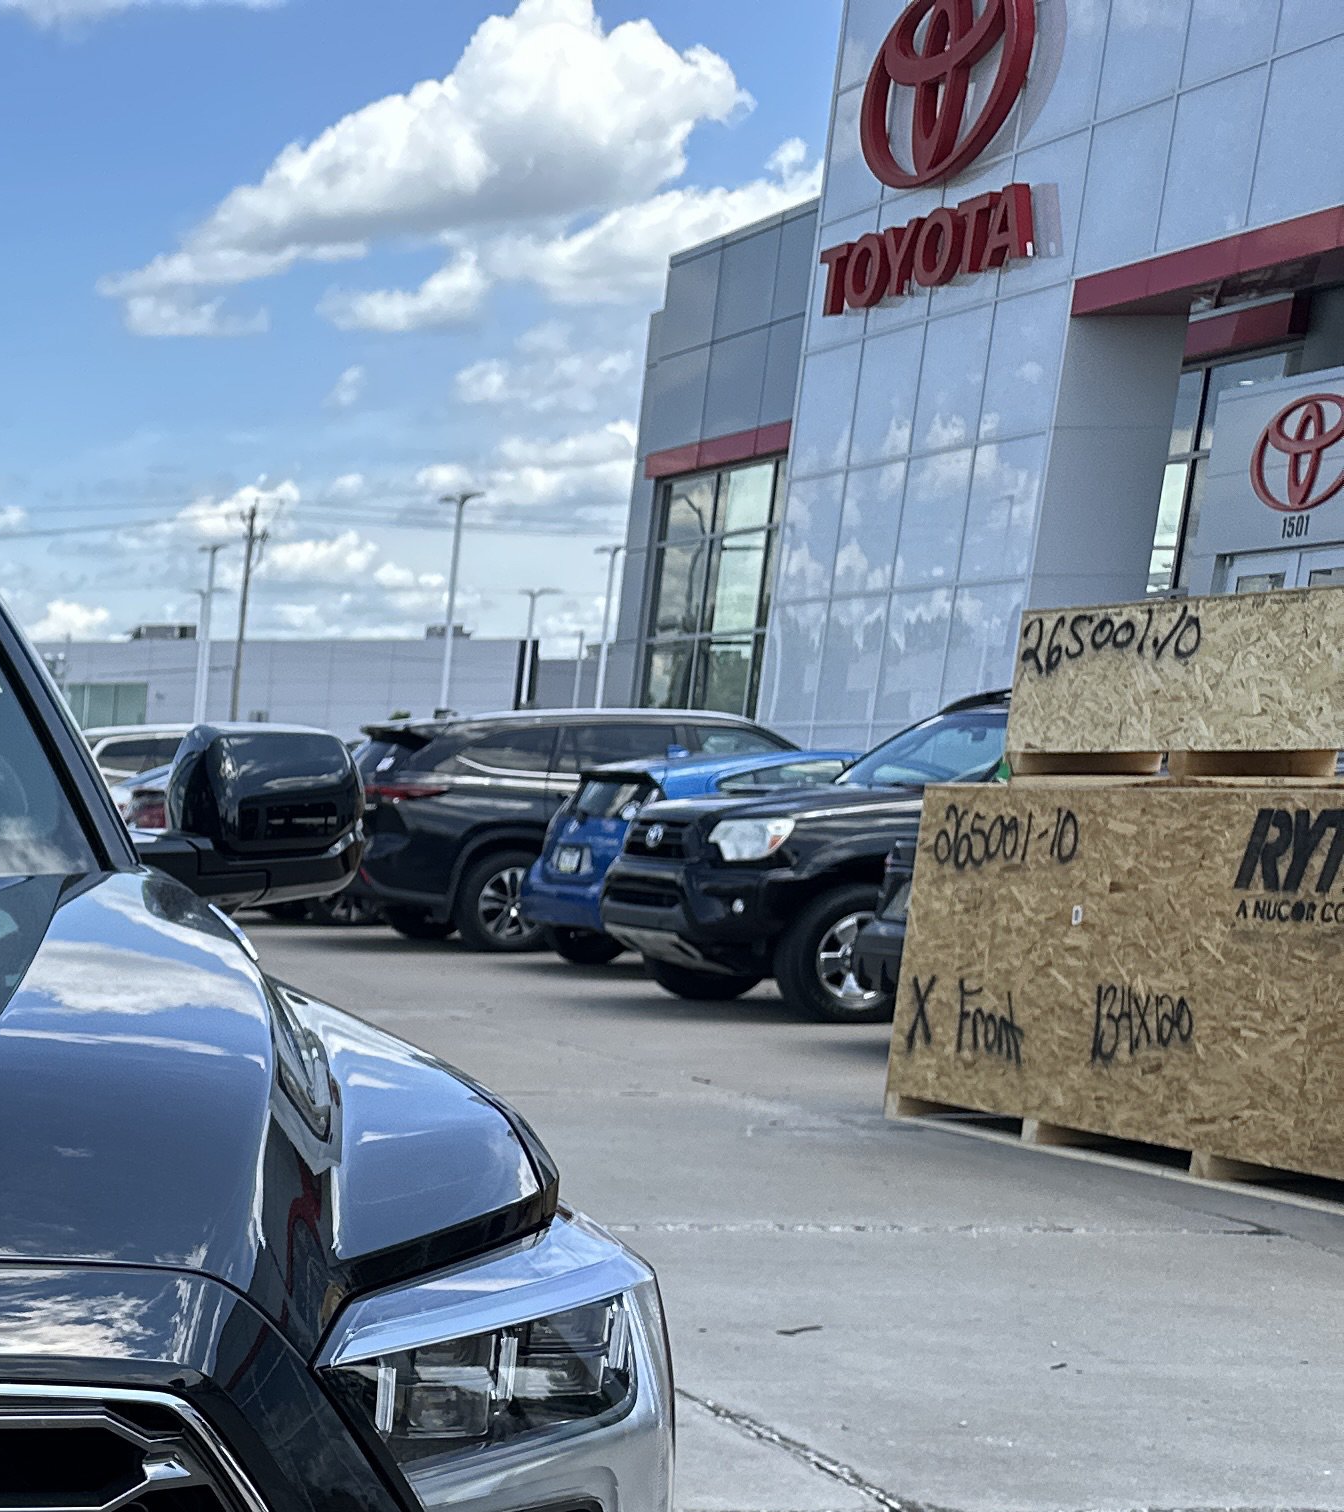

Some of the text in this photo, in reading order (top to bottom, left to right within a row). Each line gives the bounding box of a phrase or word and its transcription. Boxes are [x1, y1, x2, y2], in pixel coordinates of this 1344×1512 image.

[820, 183, 1034, 316] TOYOTA
[1281, 514, 1311, 539] 1501
[1233, 808, 1344, 893] RYT
[1236, 901, 1248, 919] A
[1253, 901, 1317, 922] NUCOR
[906, 974, 937, 1050] X
